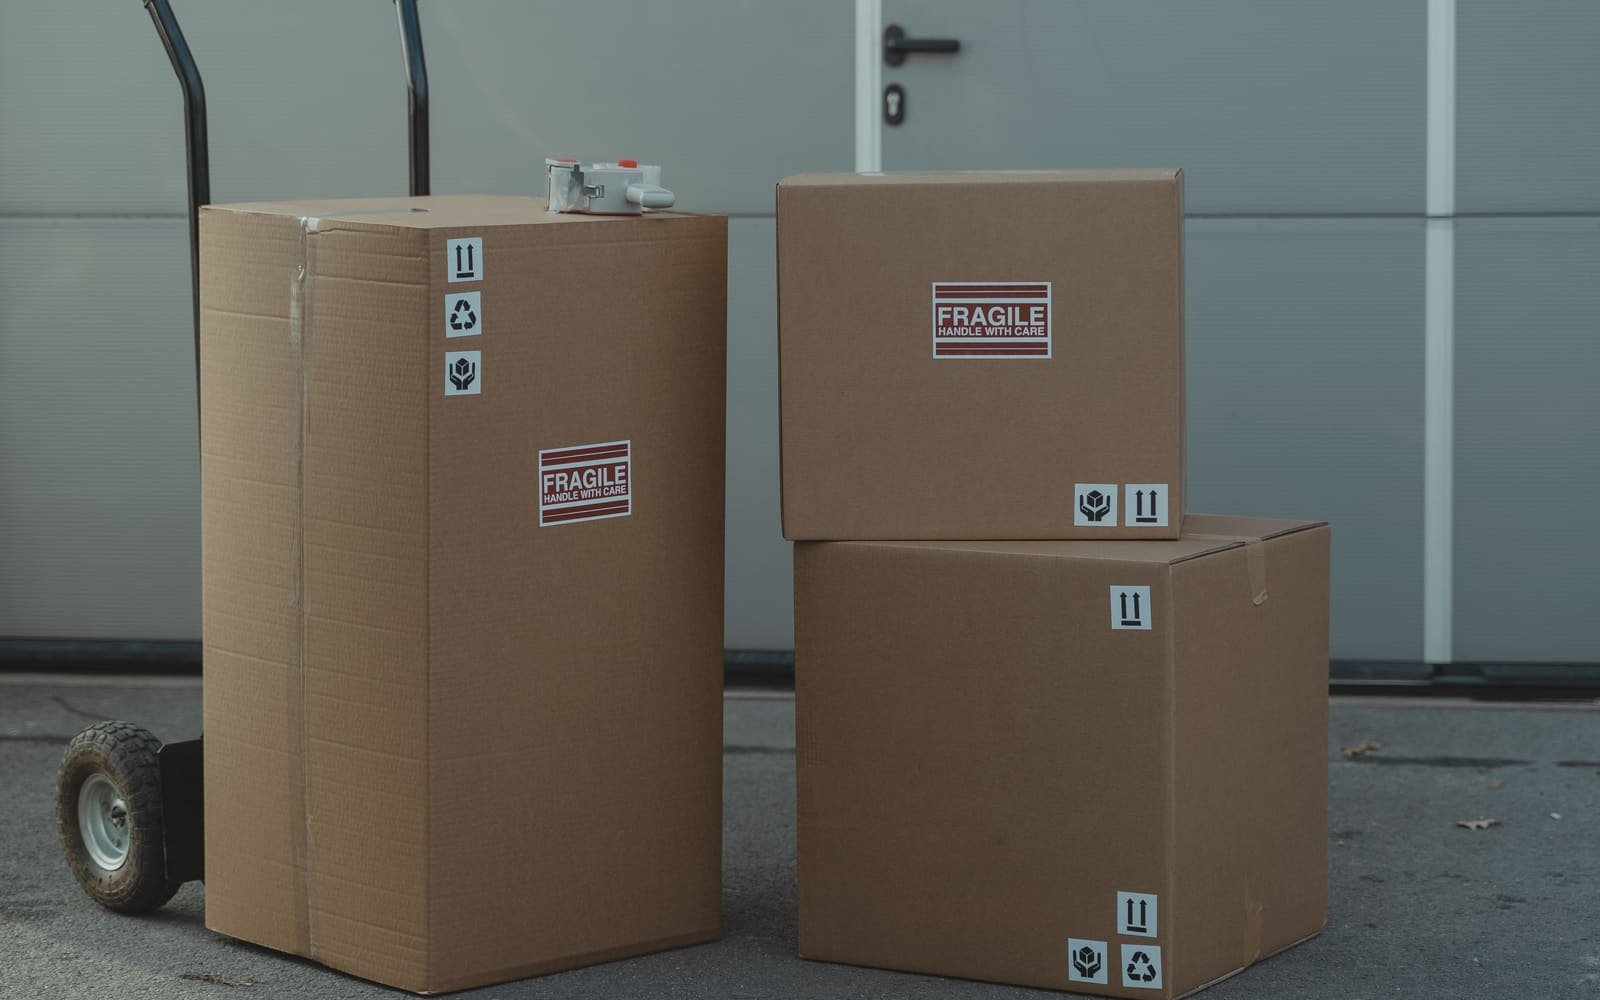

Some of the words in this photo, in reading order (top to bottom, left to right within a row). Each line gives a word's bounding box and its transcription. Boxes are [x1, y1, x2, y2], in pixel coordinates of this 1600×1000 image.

[937, 306, 1045, 326] FRAGILE
[938, 327, 982, 336] HANDLE
[984, 327, 1012, 336] WITH
[1014, 327, 1045, 336] CARE
[543, 465, 627, 494] FRAGILE
[544, 491, 579, 504] HANDLE
[580, 487, 602, 499] WITH
[603, 485, 627, 496] CARE
